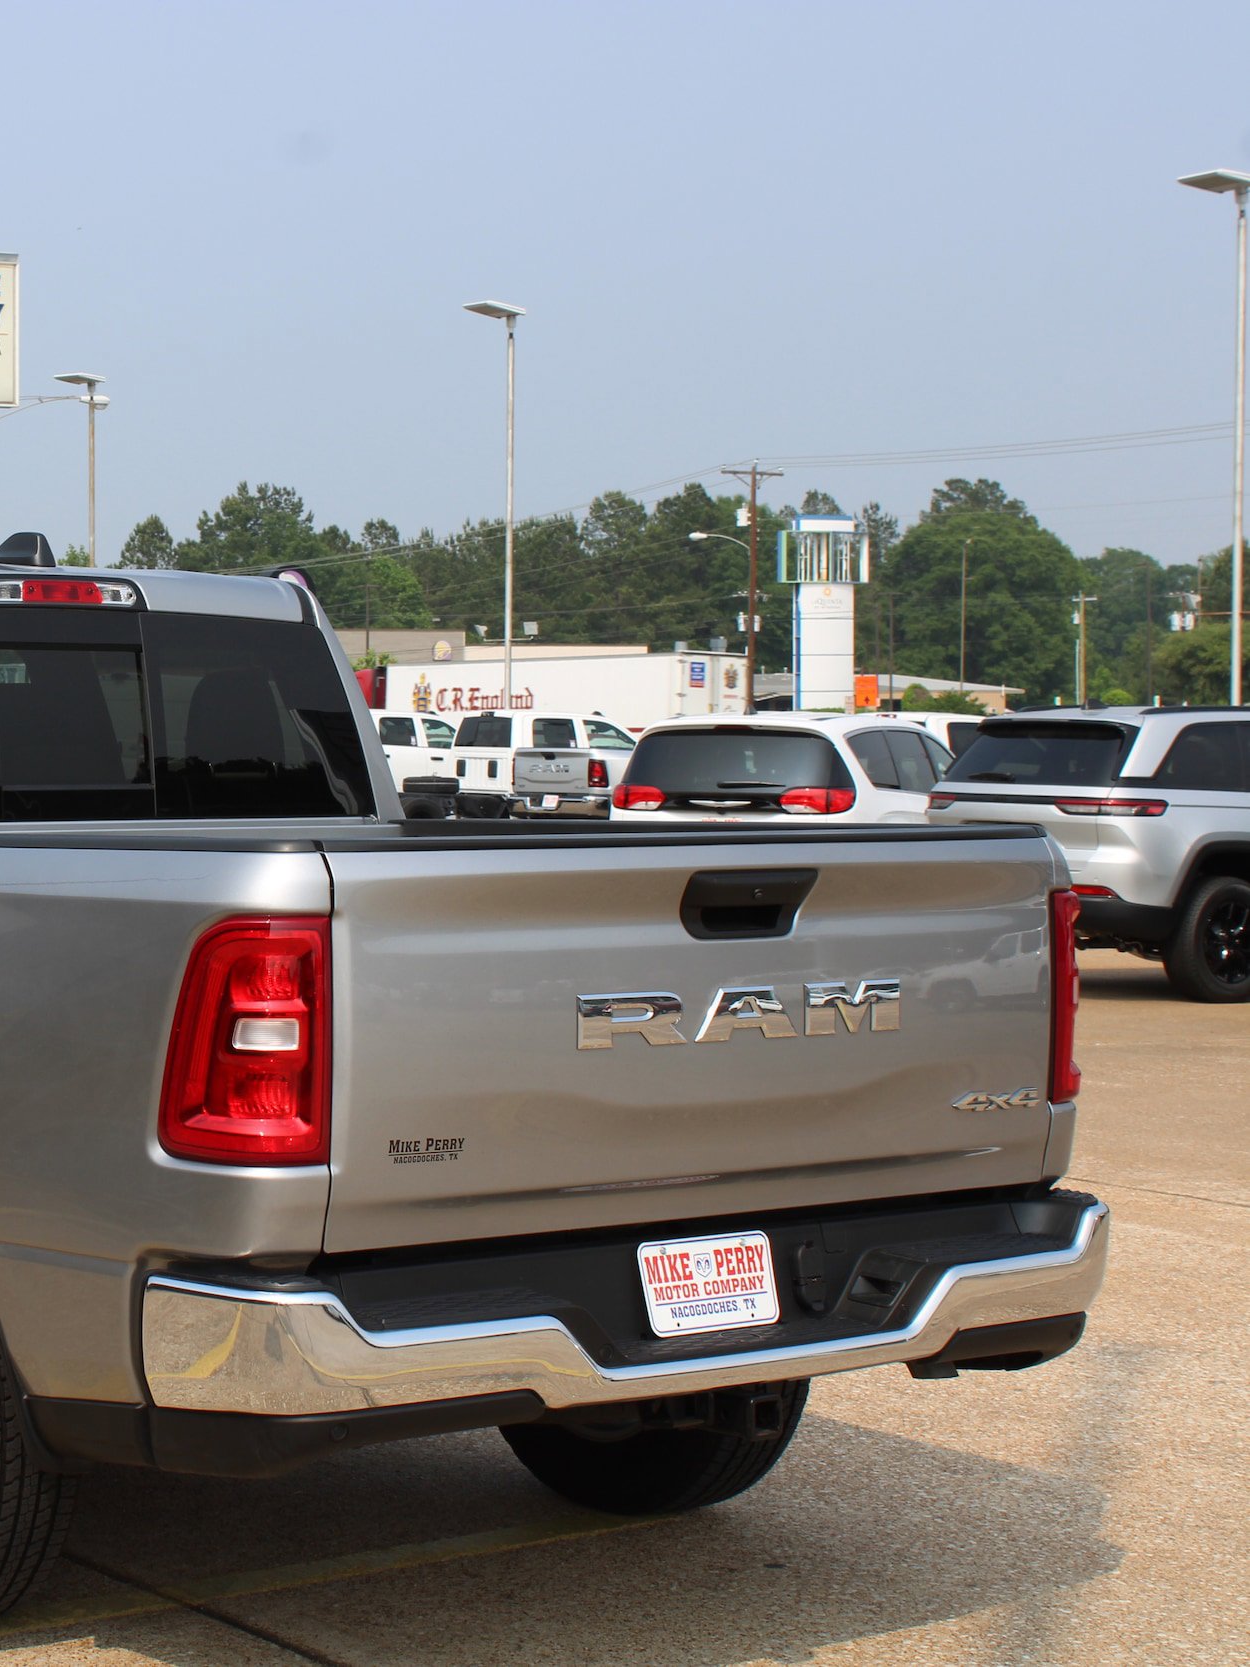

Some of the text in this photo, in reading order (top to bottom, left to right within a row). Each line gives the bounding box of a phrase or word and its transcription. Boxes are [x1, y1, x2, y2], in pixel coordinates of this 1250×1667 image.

[576, 978, 901, 1050] RAM
[951, 1086, 1040, 1112] 4x4
[449, 1152, 459, 1161] TX
[644, 1244, 765, 1285] MIKE PERRY
[653, 1275, 765, 1302] MOTOR COMPANY
[743, 1298, 757, 1310] TX
